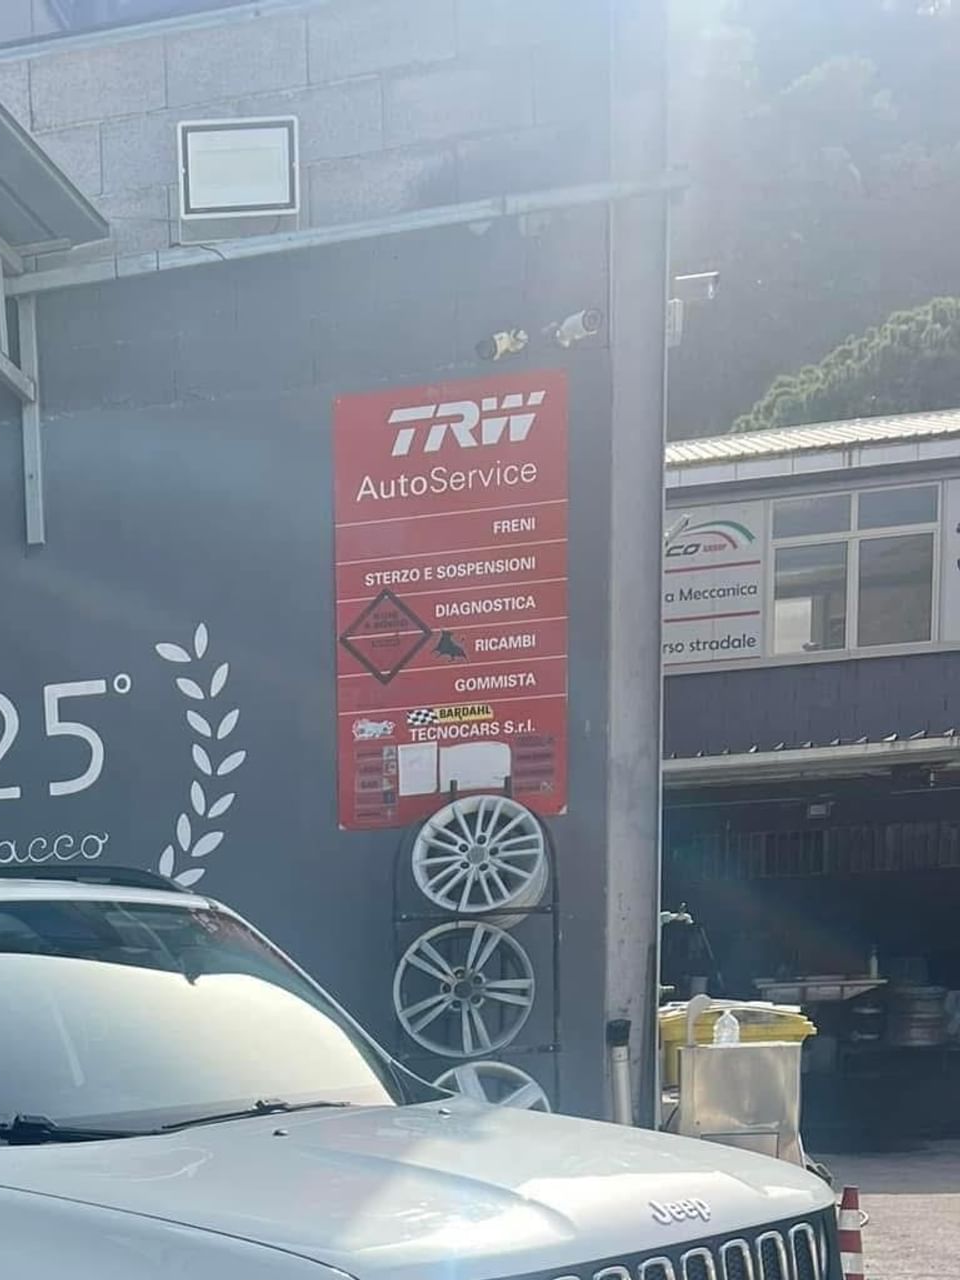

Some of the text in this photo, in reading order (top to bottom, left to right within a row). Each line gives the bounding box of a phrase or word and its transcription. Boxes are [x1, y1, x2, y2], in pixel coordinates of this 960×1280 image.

[388, 390, 546, 457] TRW
[356, 460, 538, 502] AutoService
[493, 517, 536, 535] FRENI
[365, 556, 536, 587] STERZO E SOSPENSIONI
[680, 584, 758, 601] Meccanica
[435, 596, 536, 618] DIAGNOSTICA
[475, 634, 536, 652] RICAMBI
[689, 633, 757, 652] stradale
[455, 673, 536, 692] GOMMISTA
[439, 704, 491, 721] BARDAHL
[409, 719, 536, 742] TECNOCARS S.r.l.
[648, 1199, 711, 1225] Jeep
